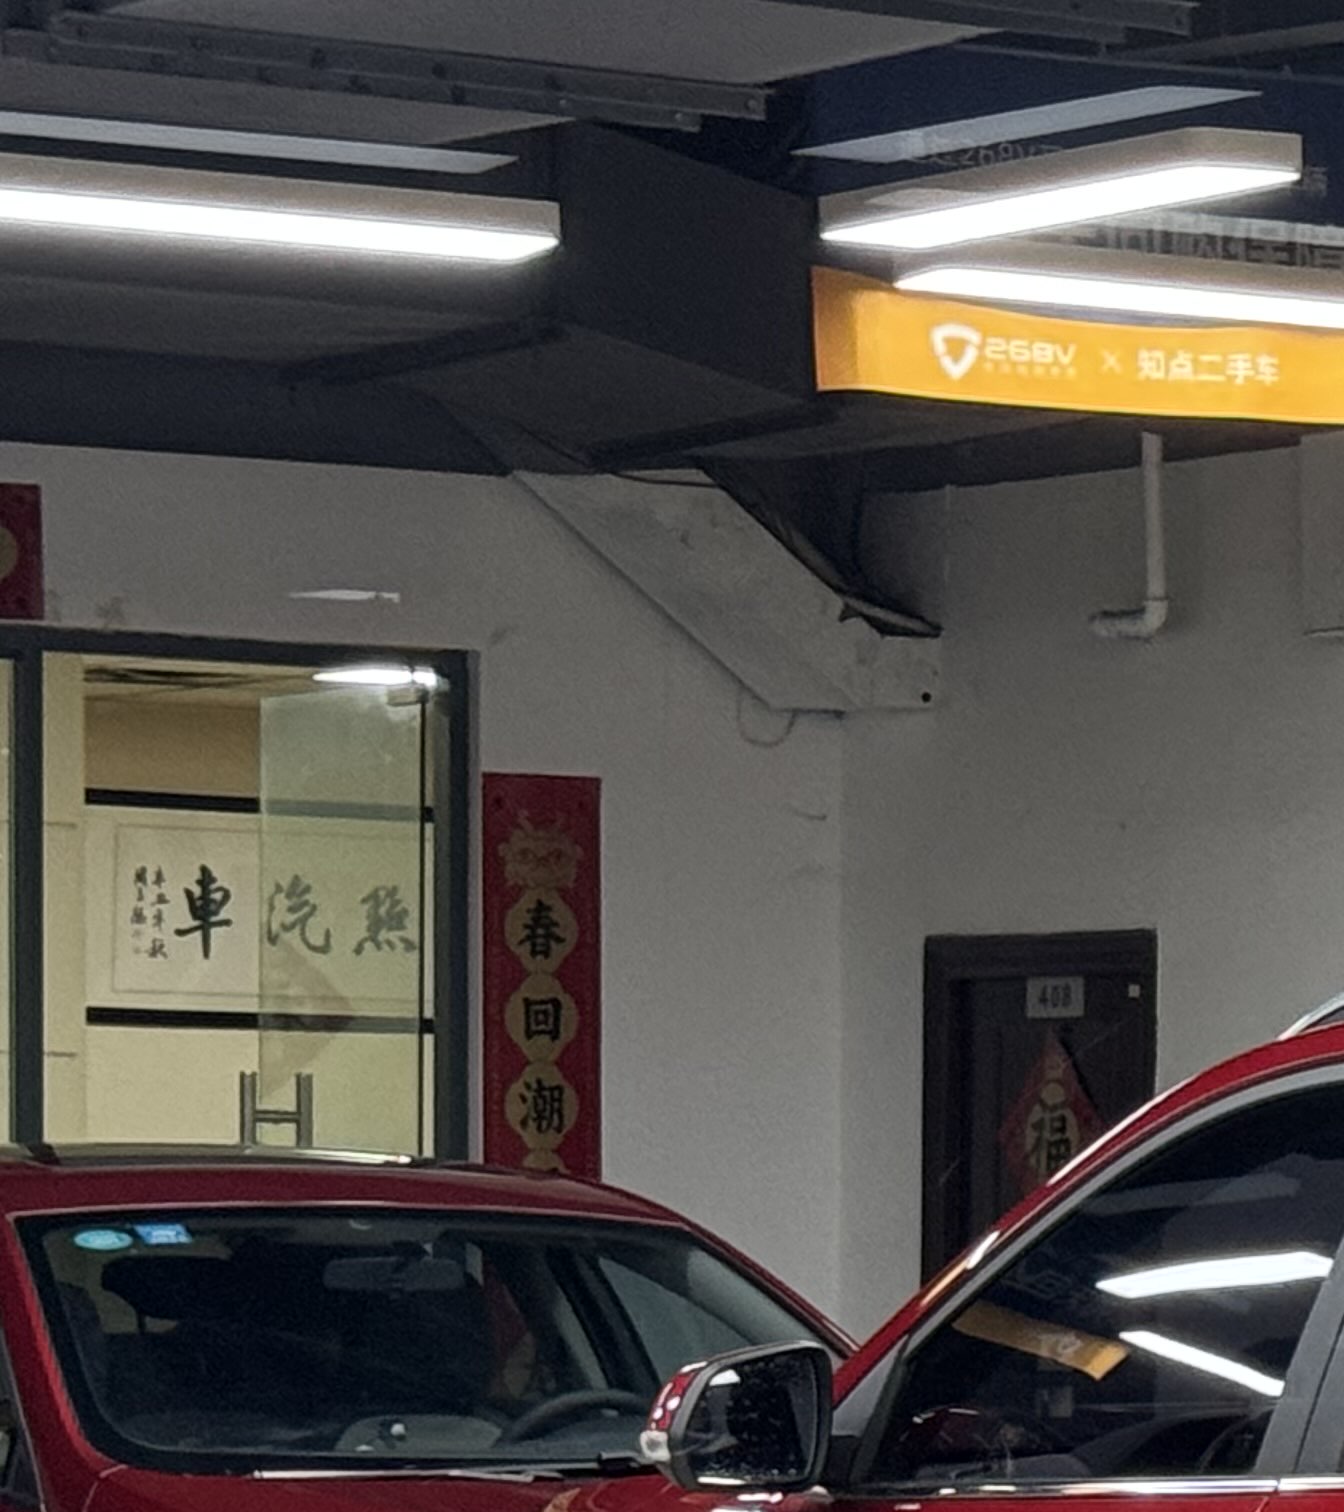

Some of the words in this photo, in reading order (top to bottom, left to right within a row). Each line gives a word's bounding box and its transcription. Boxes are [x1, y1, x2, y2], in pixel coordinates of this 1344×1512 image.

[983, 336, 1077, 366] 268V
[1136, 348, 1281, 386] 知点二手车
